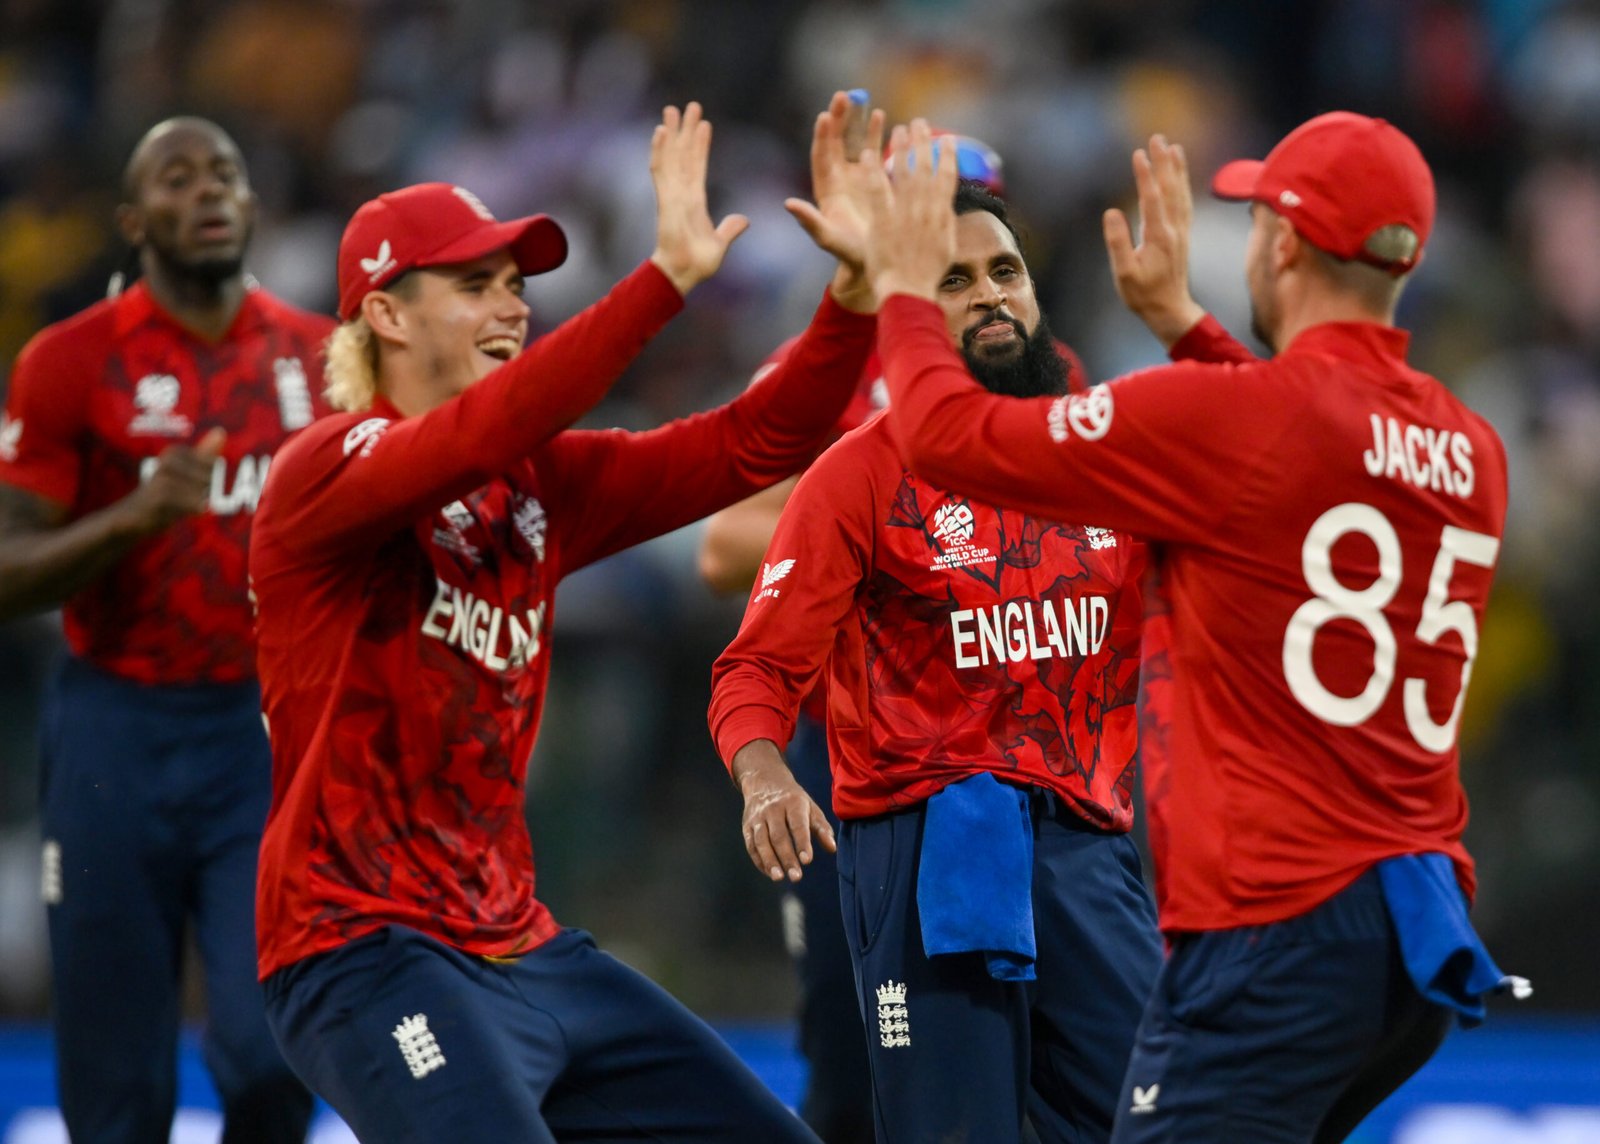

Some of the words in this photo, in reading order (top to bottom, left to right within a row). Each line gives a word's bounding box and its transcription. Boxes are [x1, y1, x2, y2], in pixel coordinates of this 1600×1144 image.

[1363, 413, 1476, 499] JACKS
[933, 551, 969, 564] WORLD
[971, 548, 989, 558] CUP
[950, 537, 966, 546] ICC
[963, 557, 983, 565] LANKA
[950, 596, 1109, 669] ENGLAND
[1282, 502, 1500, 754] 85
